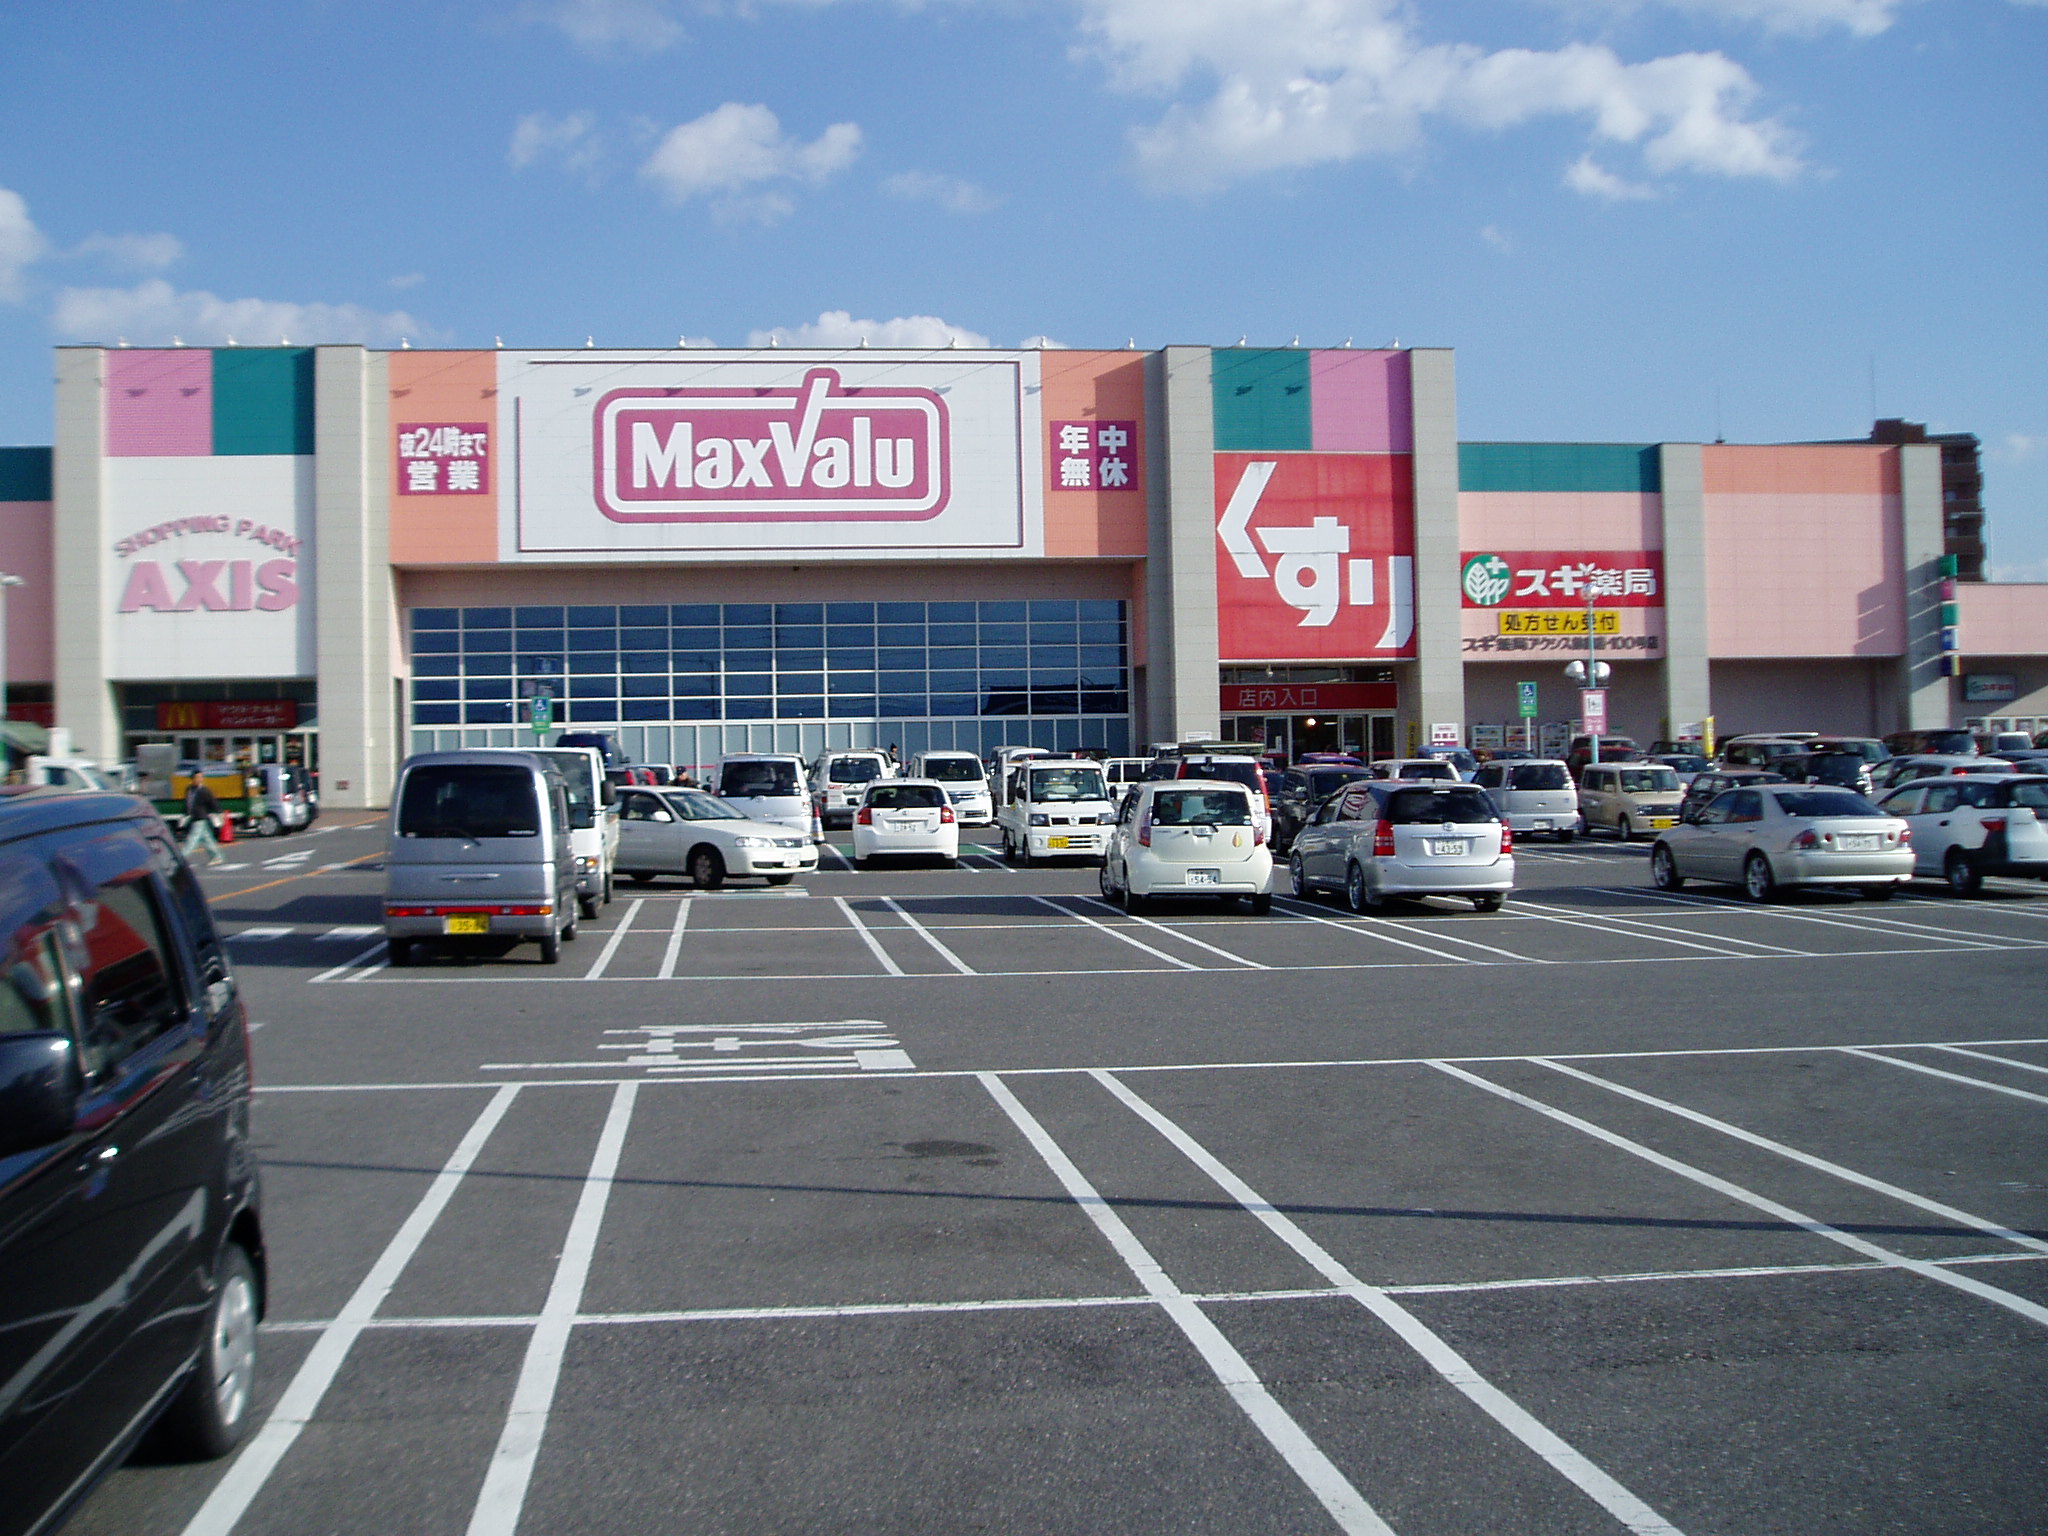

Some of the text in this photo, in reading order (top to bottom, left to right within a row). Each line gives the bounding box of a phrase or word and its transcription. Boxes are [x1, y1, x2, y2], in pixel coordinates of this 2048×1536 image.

[399, 427, 486, 458] 夜24時まで
[632, 377, 916, 488] MaxValu
[1059, 424, 1127, 454] 年中
[407, 460, 480, 491] 営業
[1060, 457, 1129, 487] 無休
[113, 513, 303, 557] SHOPPING PARK
[1217, 462, 1414, 649] くすり
[116, 558, 301, 613] AXIS
[1515, 562, 1656, 597] スギ薬局
[1506, 613, 1616, 631] 処方せん受付
[1239, 688, 1317, 707] 店内入口
